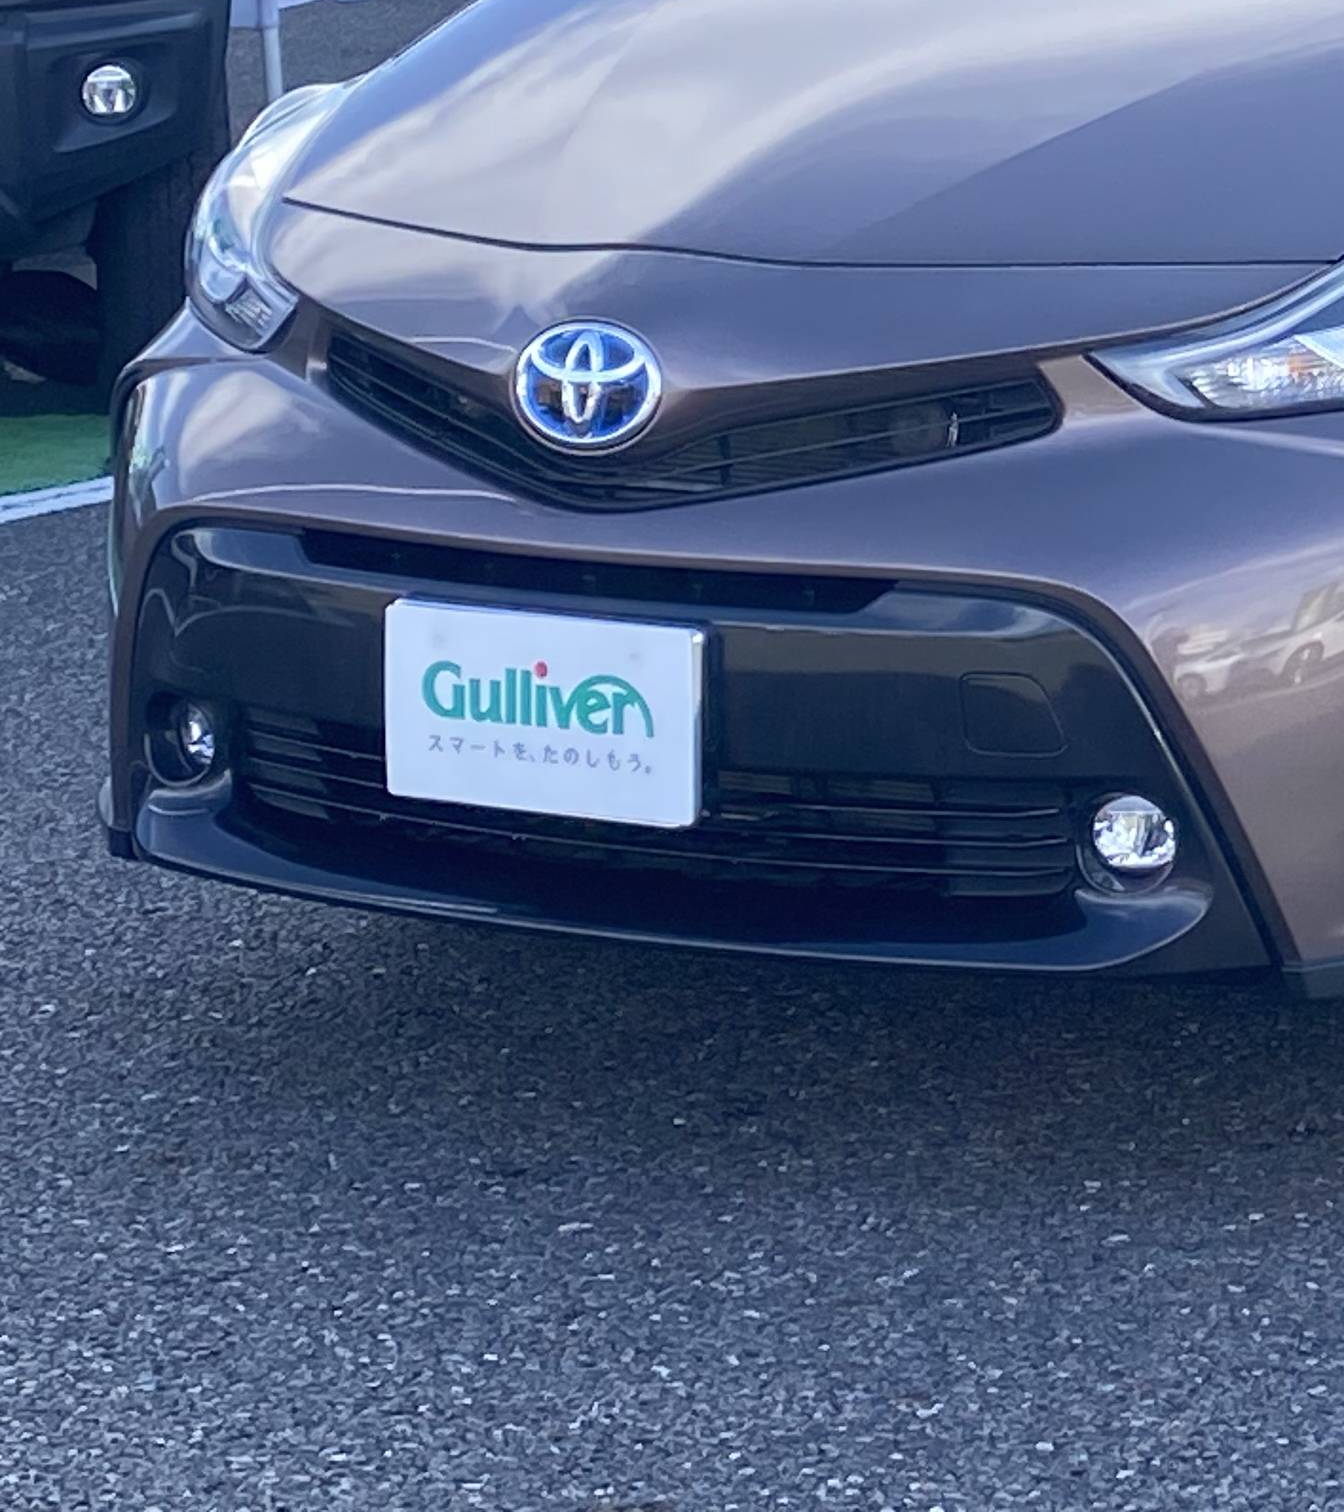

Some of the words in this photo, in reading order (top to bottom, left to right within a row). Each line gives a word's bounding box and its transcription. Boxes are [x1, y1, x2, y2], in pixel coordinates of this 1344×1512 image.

[421, 659, 655, 739] Gulliver
[427, 734, 652, 775] スマートを、たのしもう。
